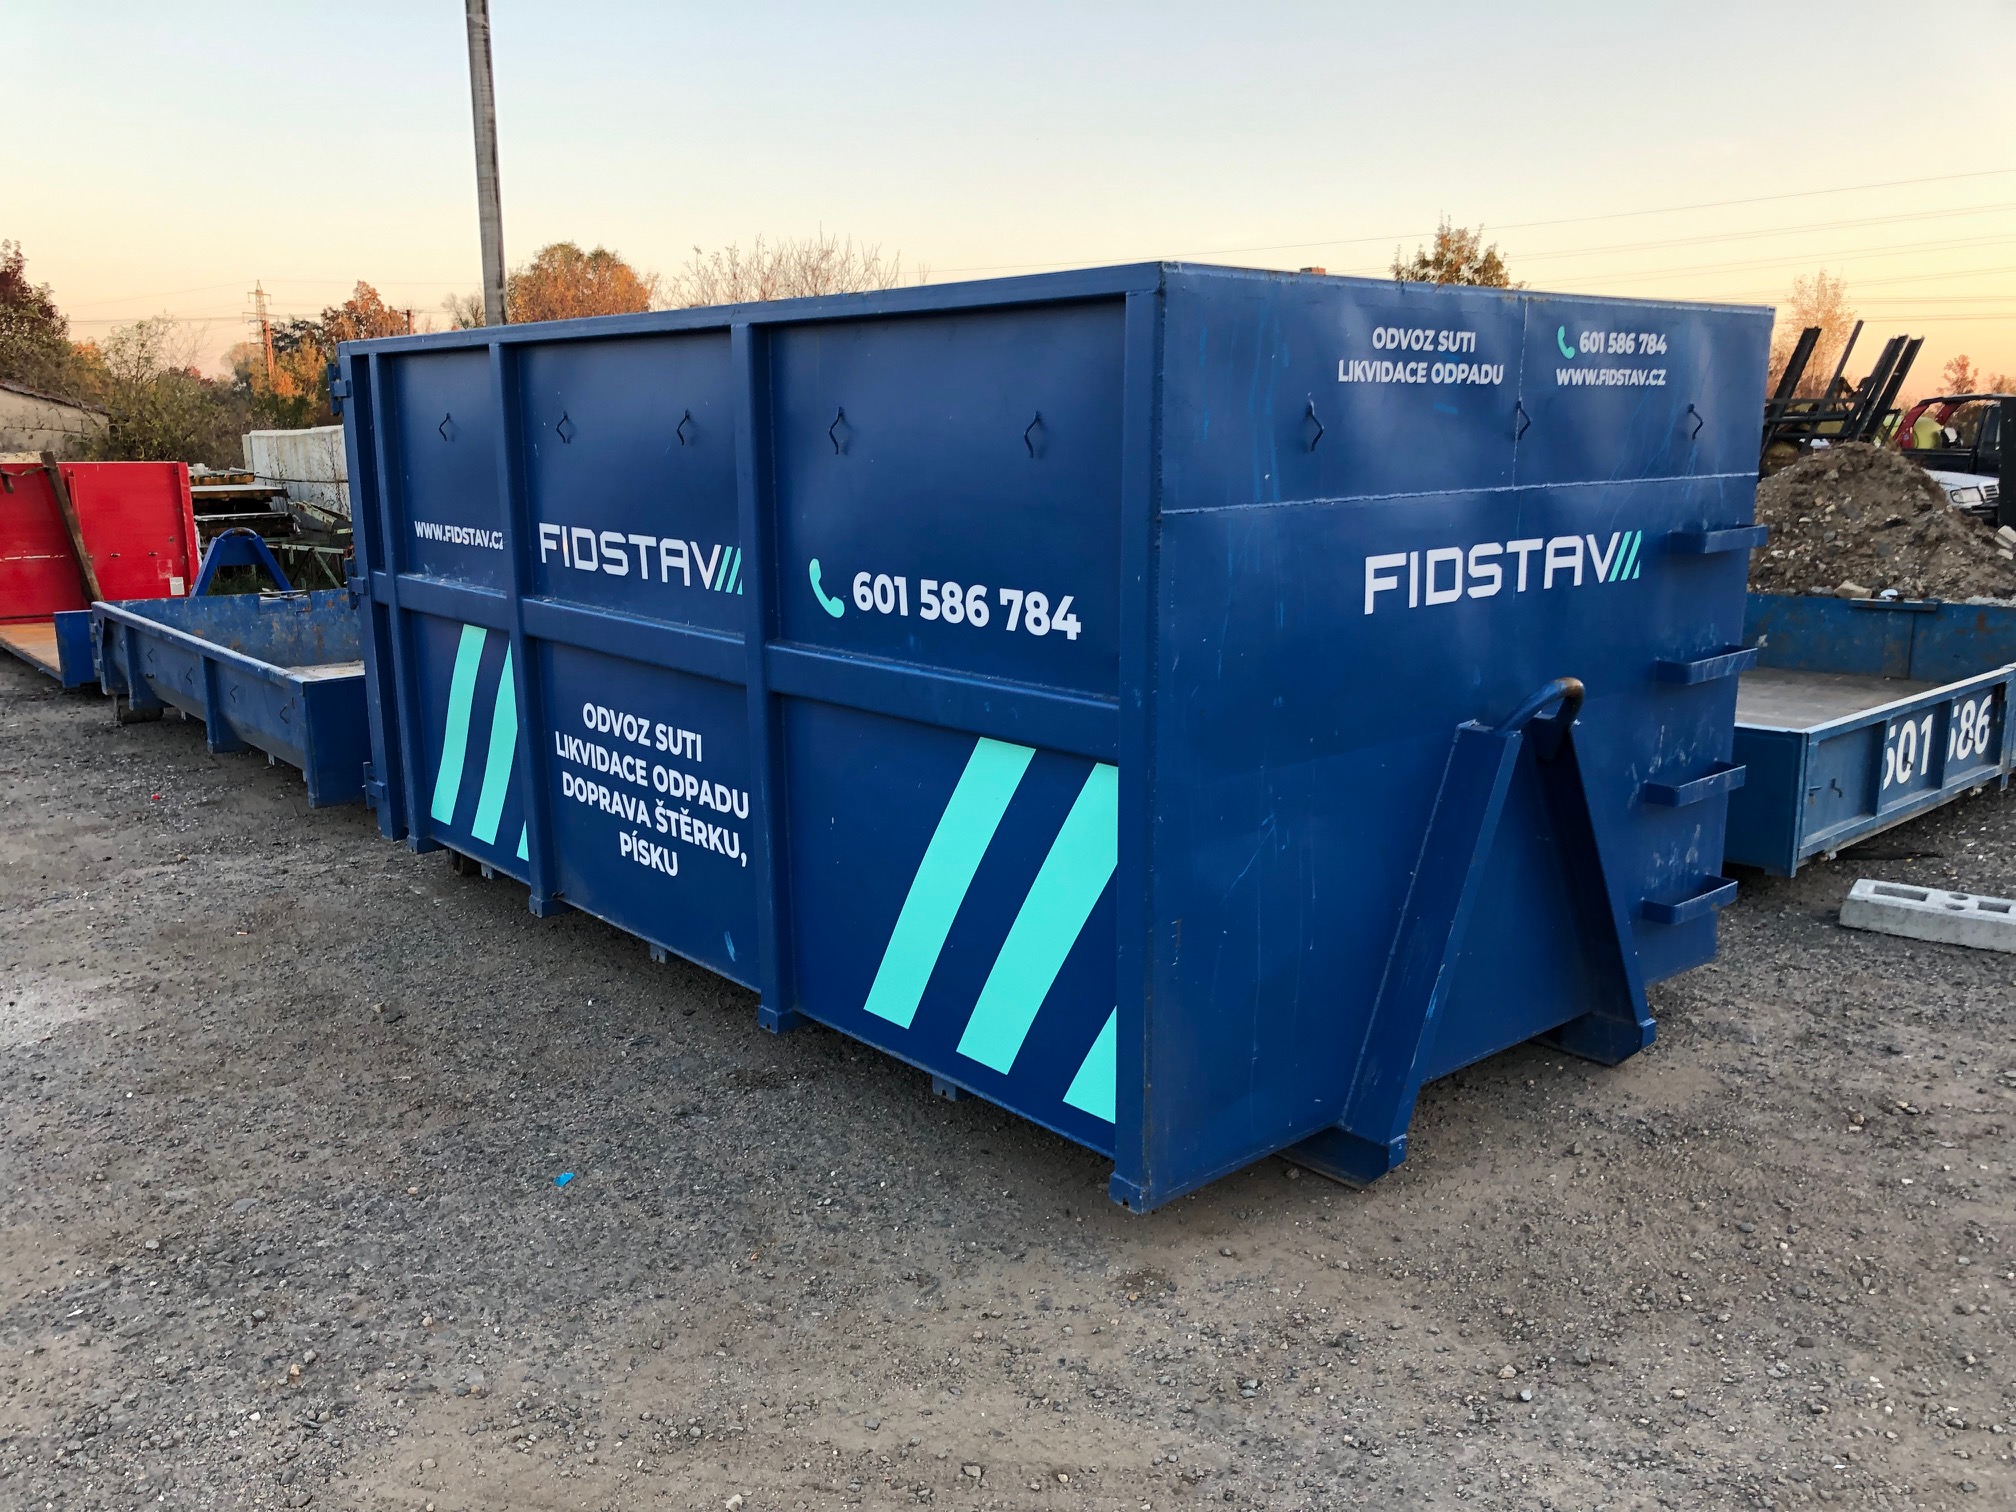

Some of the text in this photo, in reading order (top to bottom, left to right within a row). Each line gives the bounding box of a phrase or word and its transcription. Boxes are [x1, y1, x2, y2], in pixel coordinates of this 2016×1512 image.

[1372, 326, 1477, 353] ODVOZ SUTI
[1579, 329, 1668, 355] 601 586 784
[1337, 359, 1505, 386] LIKVIDACE ODPADU
[1556, 368, 1667, 387] WWW.FIDSTAV.CZ
[539, 522, 722, 591] FIDSTAV
[1364, 531, 1621, 616] FIDSTAV
[852, 571, 1082, 641] 601 586 784
[582, 702, 702, 763] ODVOZ SUTI
[555, 730, 749, 820] LIKVIDACE ODPADU
[562, 770, 748, 867] DOPRAVA ŠTĚRKU,
[619, 826, 679, 877] PÍSKU
